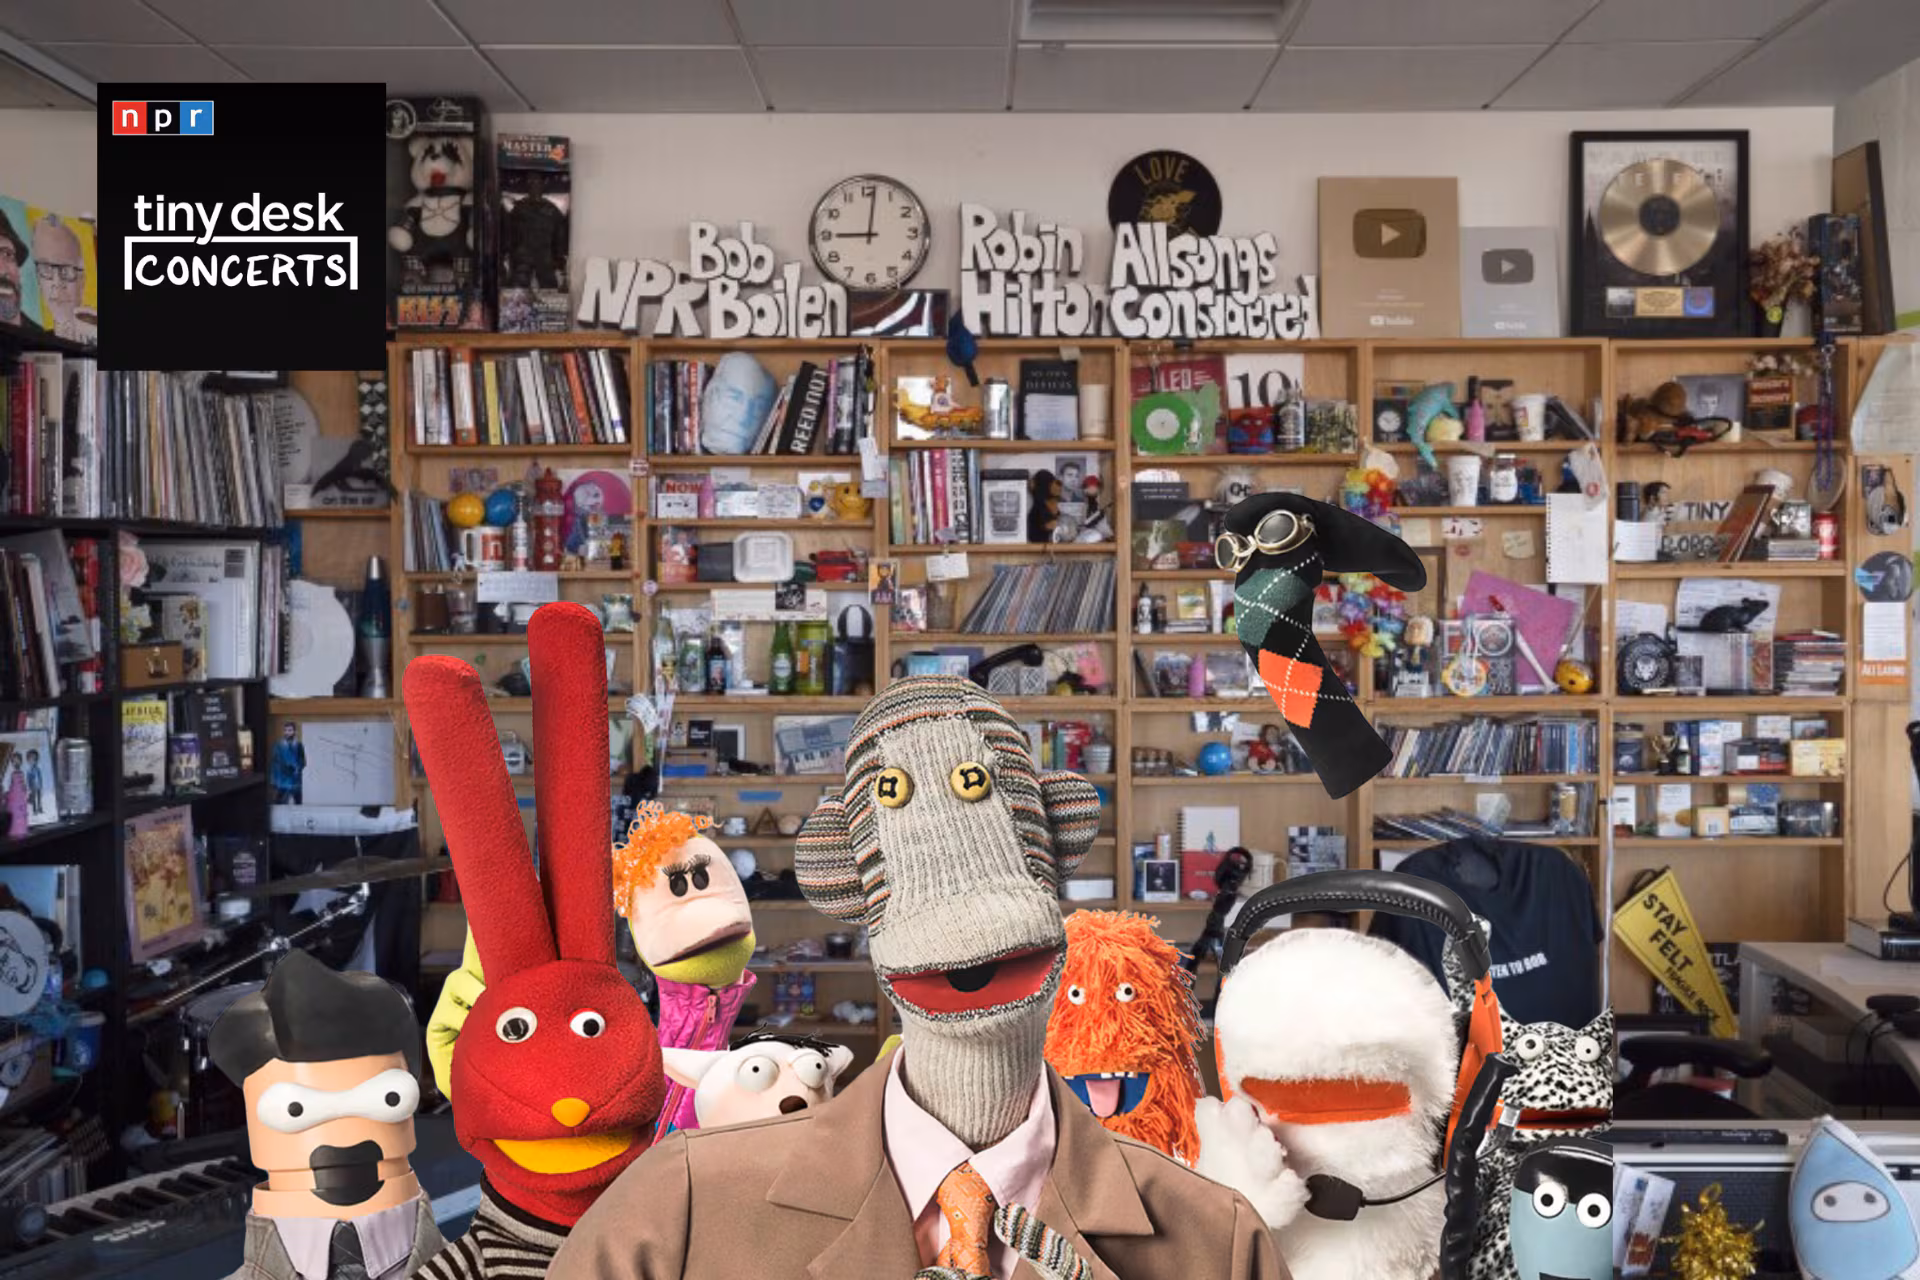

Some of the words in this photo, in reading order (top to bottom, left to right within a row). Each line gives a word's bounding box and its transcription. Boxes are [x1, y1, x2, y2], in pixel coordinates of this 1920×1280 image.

[1135, 155, 1189, 185] LOVE
[843, 191, 853, 203] 11
[887, 190, 893, 202] 1
[828, 208, 840, 219] 10
[900, 206, 911, 218] 2
[821, 229, 832, 241] 9
[907, 226, 918, 240] 3
[961, 203, 1083, 275] Robin
[690, 221, 774, 284] Bob
[828, 250, 840, 263] 8
[901, 249, 912, 261] 4
[843, 265, 854, 279] 7
[864, 272, 876, 285] 6
[886, 265, 898, 278] 5
[577, 256, 708, 336] NPR
[708, 262, 847, 338] Boilen
[961, 269, 1113, 337] Hilton
[1684, 501, 1729, 521] TINY
[1643, 893, 1687, 937] STAY
[1650, 929, 1694, 972] FELT
